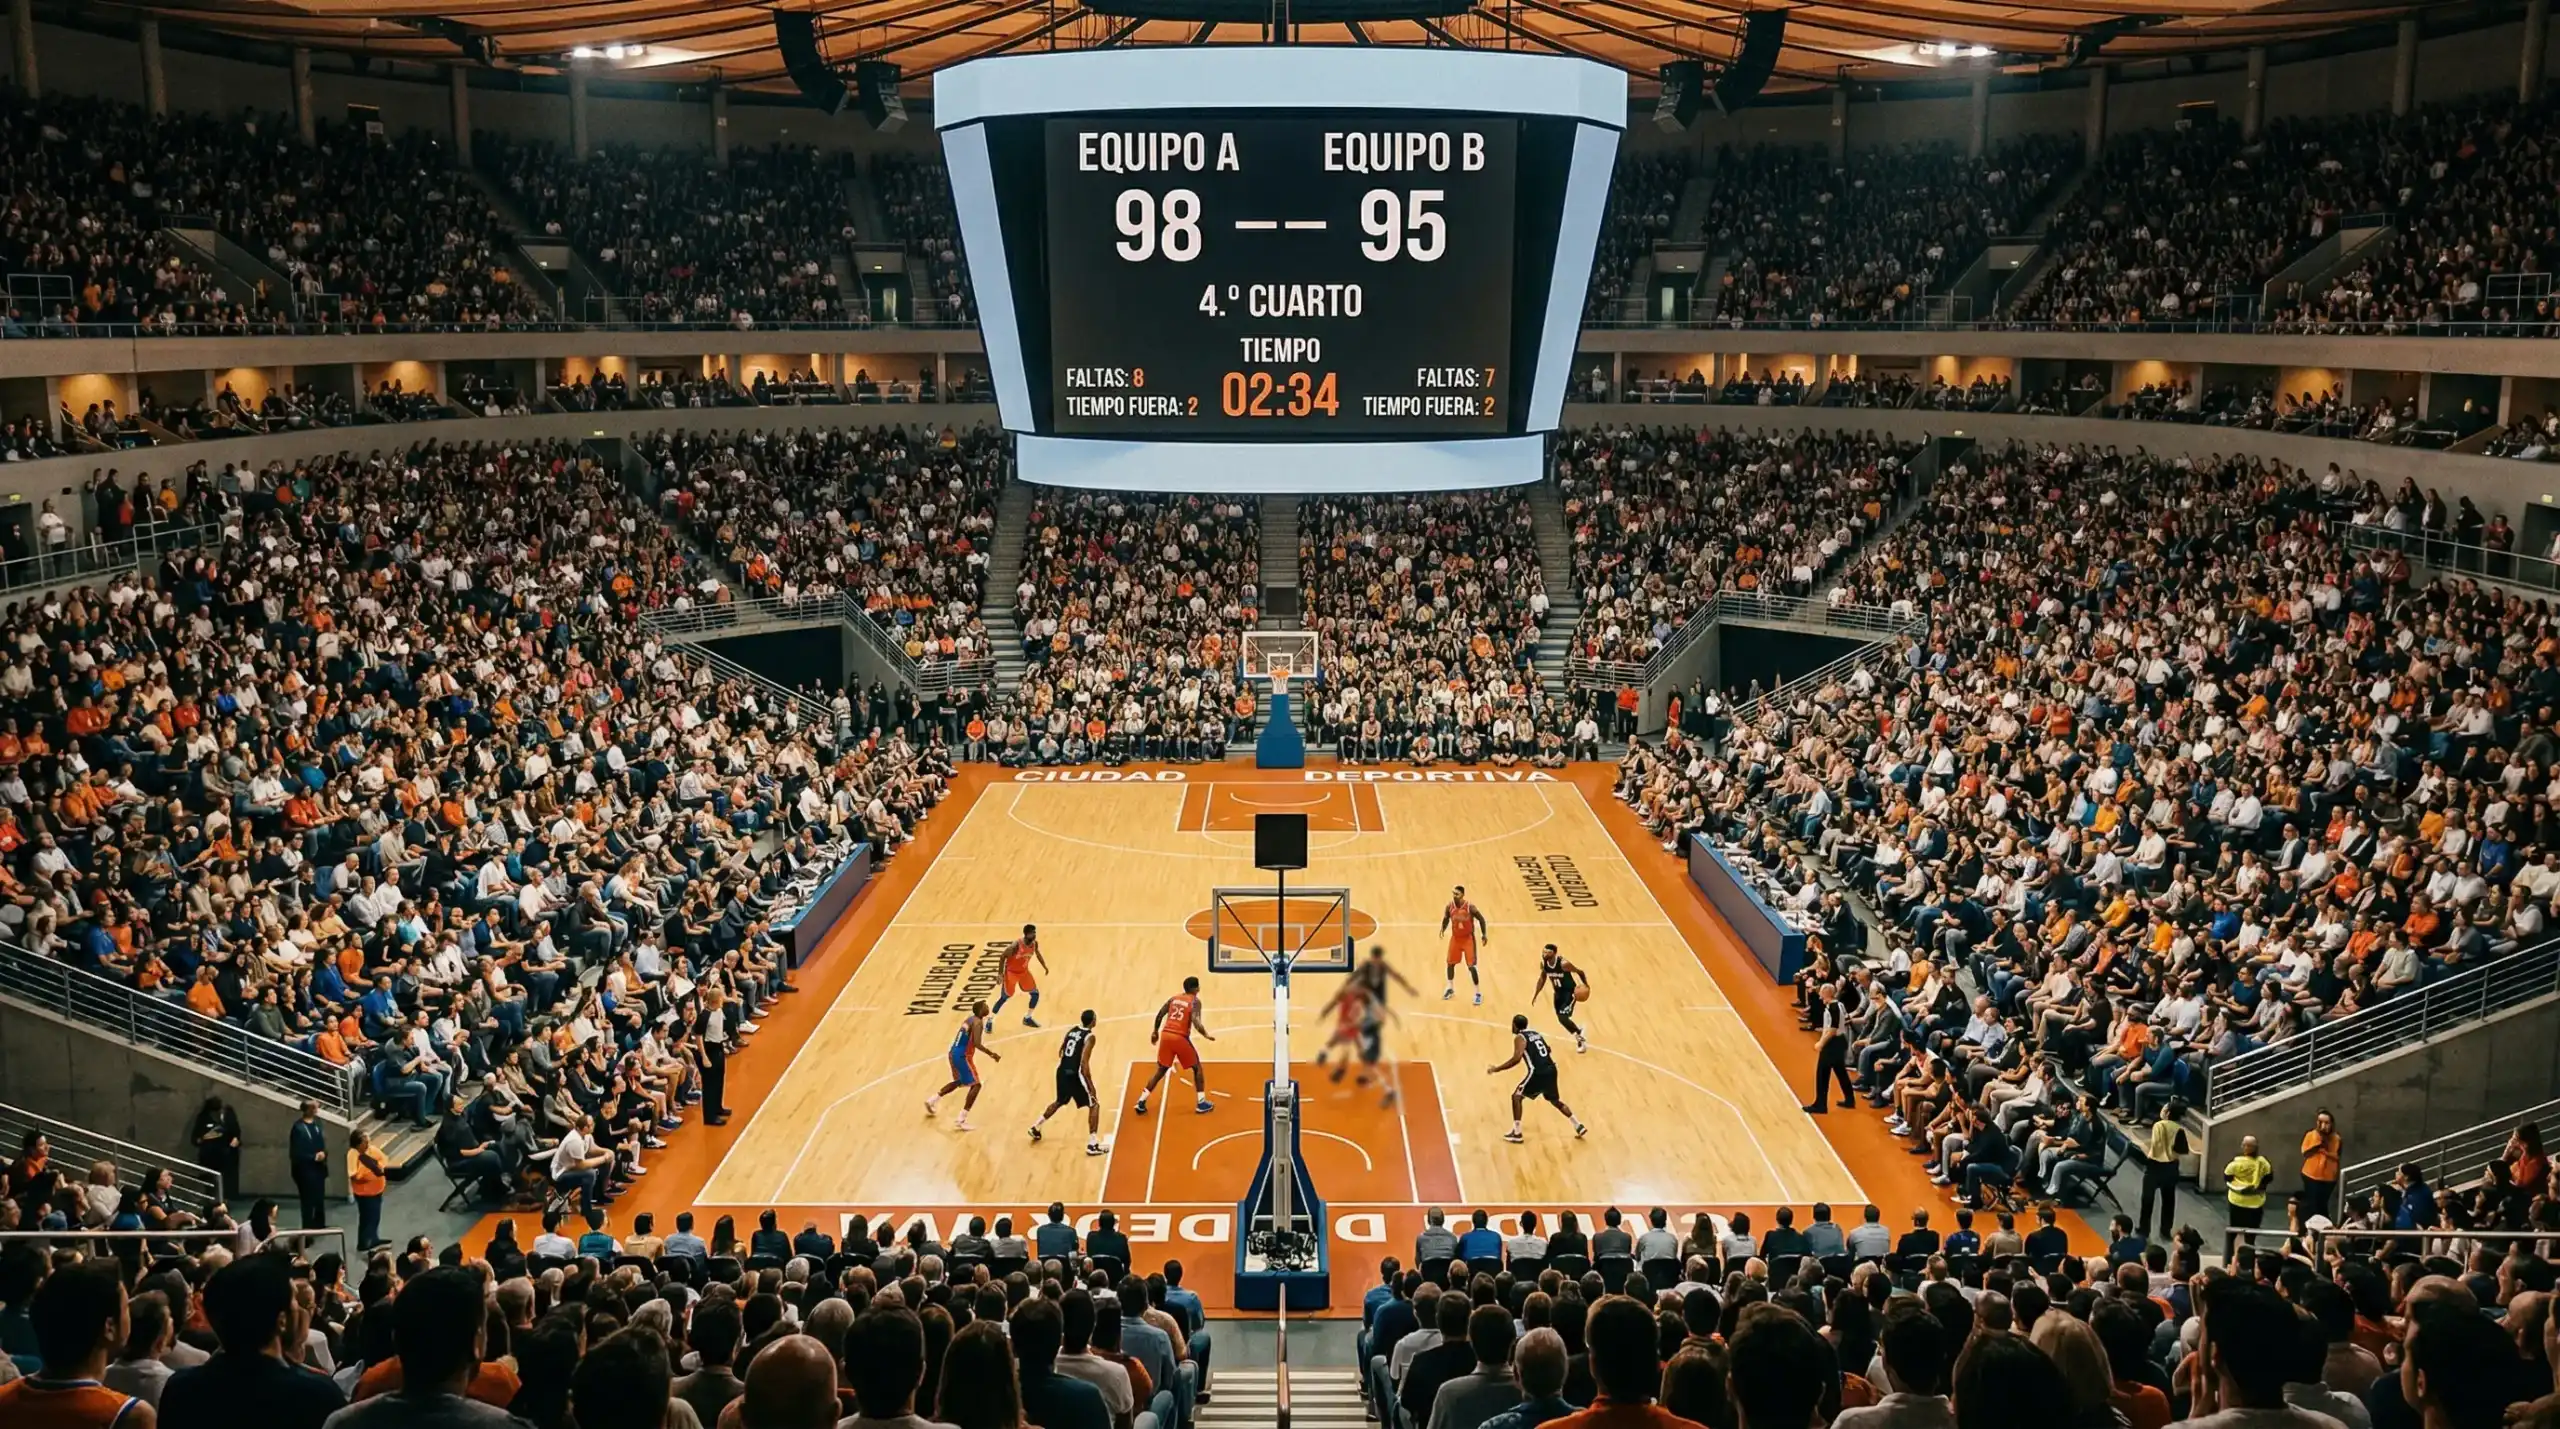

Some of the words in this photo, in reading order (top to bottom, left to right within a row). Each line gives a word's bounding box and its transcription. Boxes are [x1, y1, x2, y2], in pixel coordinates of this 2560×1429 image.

[1079, 132, 1205, 173] EQUIPO
[1216, 132, 1240, 171] A
[1324, 132, 1451, 173] EQUIPO
[1462, 132, 1485, 171] B
[1115, 188, 1202, 262] 98
[1360, 188, 1446, 262] 95
[1249, 284, 1362, 318] CUARTO
[1240, 337, 1321, 363] TIEMPO
[1066, 367, 1129, 388] FALTAS:
[1132, 367, 1144, 388] 8
[1417, 367, 1480, 388] FALTAS:
[1484, 367, 1495, 388] 7
[1066, 396, 1125, 416] TIEMPO
[1128, 396, 1184, 416] FUERA:
[1187, 396, 1198, 416] 2
[1222, 371, 1340, 417] 02:34
[1362, 396, 1421, 416] TIEMPO
[1425, 396, 1480, 416] FUERA:
[1484, 396, 1495, 416] 2
[1014, 770, 1189, 783] CIUDAD
[1304, 770, 1559, 783] DEPORTIVA
